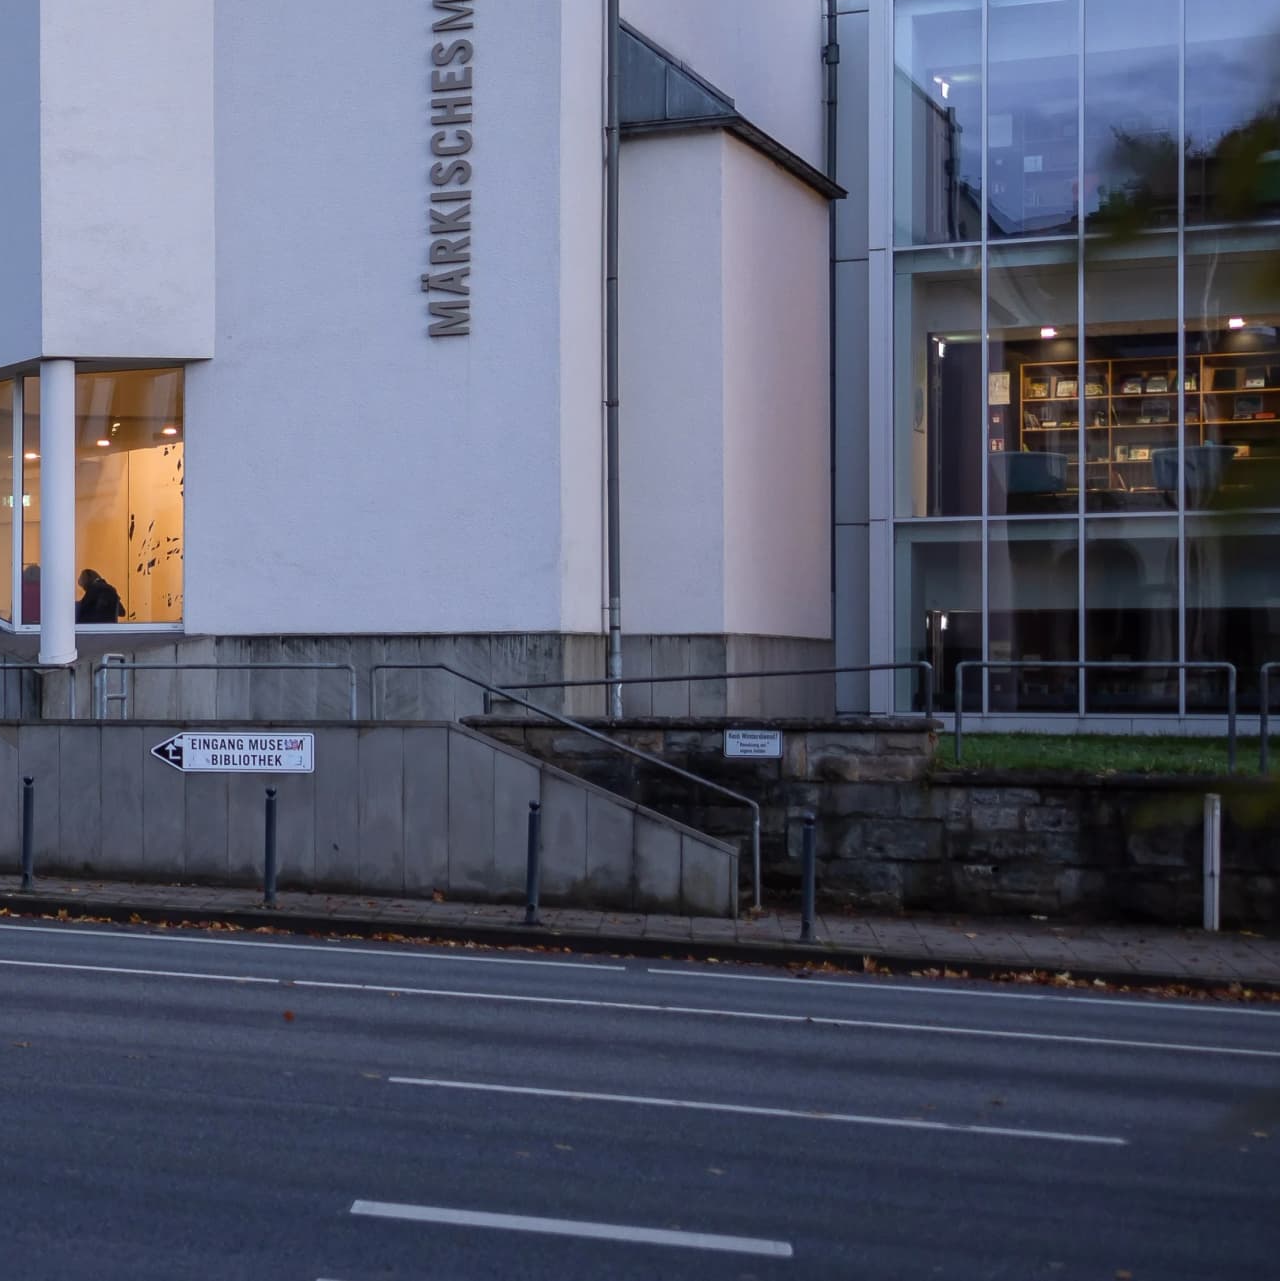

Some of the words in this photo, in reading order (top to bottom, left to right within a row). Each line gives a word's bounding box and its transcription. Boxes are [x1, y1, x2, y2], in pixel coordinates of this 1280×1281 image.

[190, 738, 244, 751] EINGANG
[248, 738, 304, 751] MUSEM
[211, 754, 283, 766] BIBLIOTHEK
